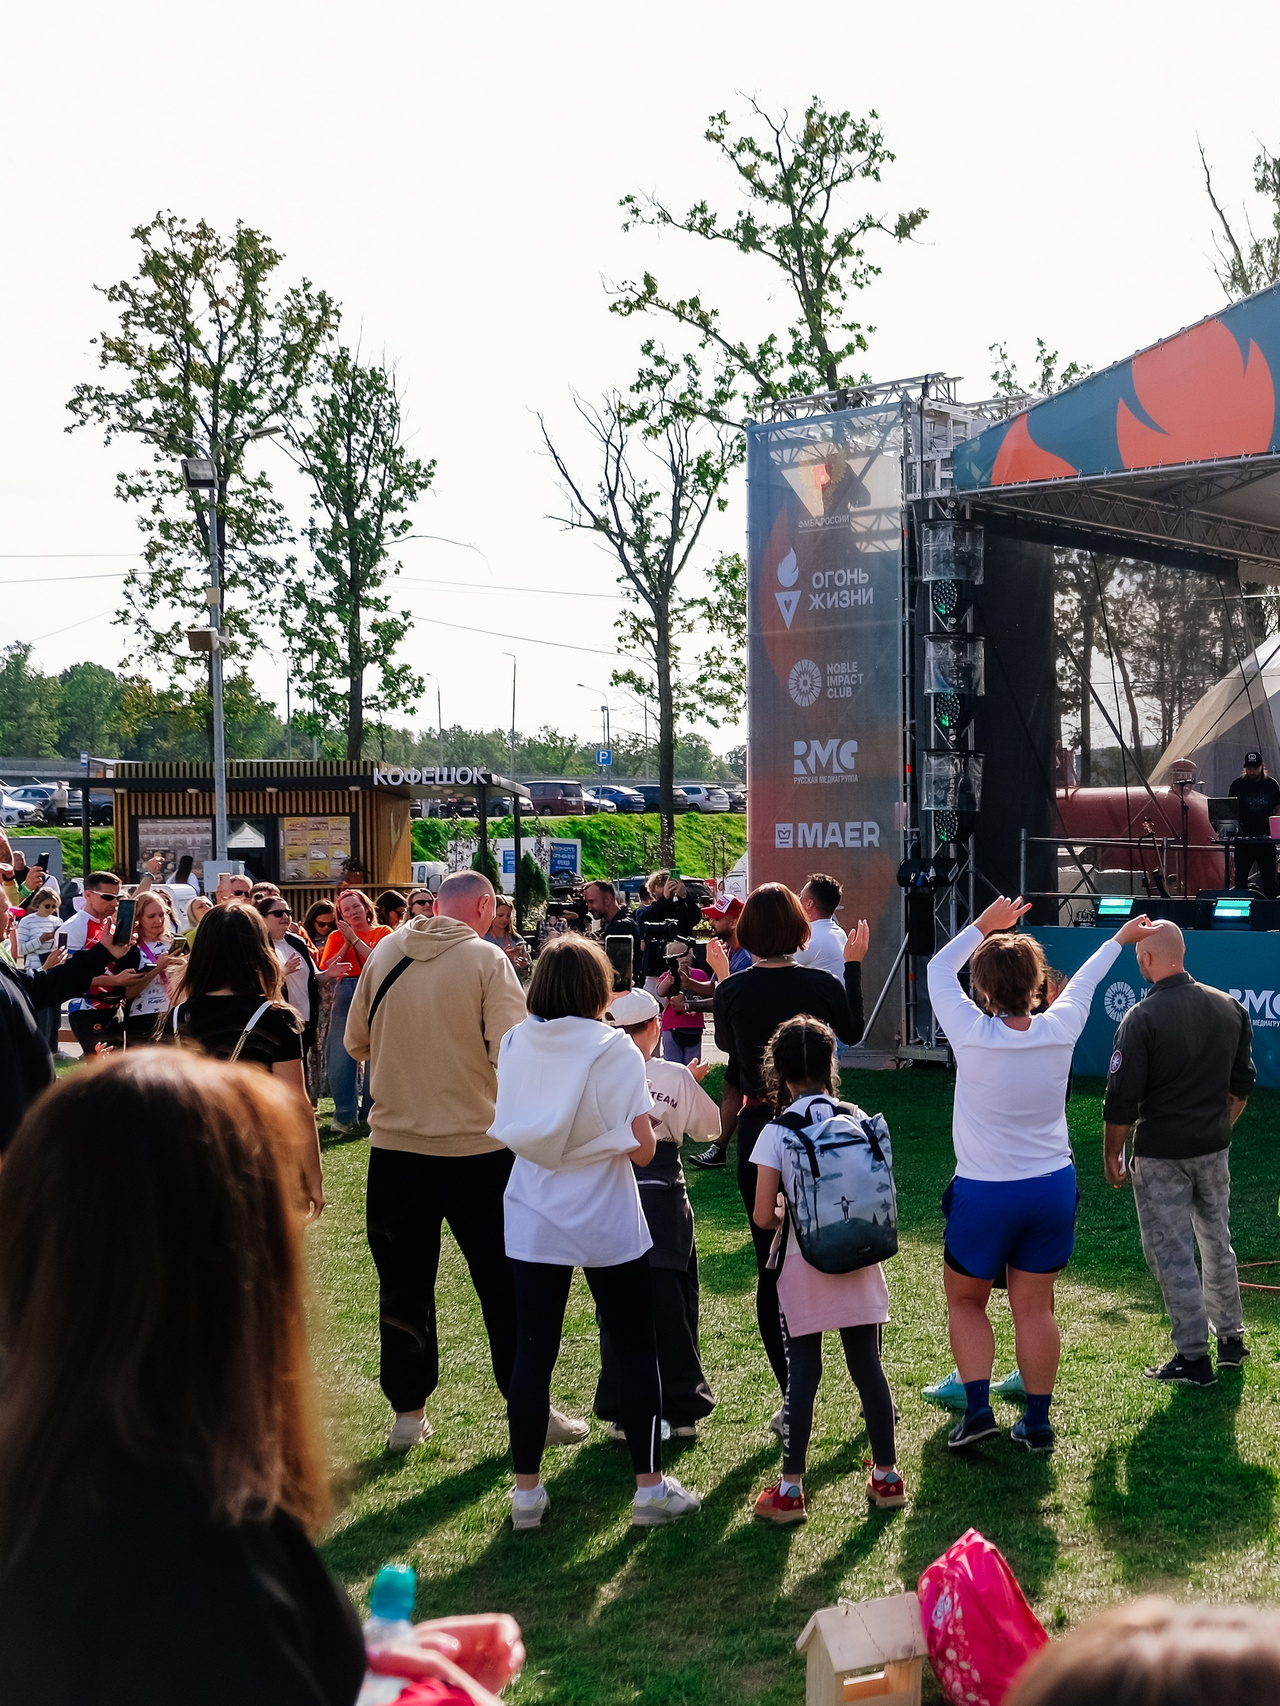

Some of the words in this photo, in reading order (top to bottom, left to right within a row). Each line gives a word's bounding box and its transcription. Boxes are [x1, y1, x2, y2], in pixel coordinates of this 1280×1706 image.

[798, 519, 821, 529] ФМБА
[822, 514, 850, 526] РОССИИ
[812, 568, 869, 589] ОГОНЬ
[808, 588, 874, 611] ЖИЗНИ
[826, 661, 858, 675] NOBLE
[826, 673, 864, 687] IMPACT
[827, 686, 852, 699] CLUB
[793, 739, 858, 775] RMG
[373, 766, 488, 787] КОФЕШОК
[793, 776, 819, 785] РУССКАЯ
[819, 774, 858, 785] МЕДИАГРУППА
[797, 821, 880, 849] MAER
[650, 1091, 678, 1109] TEAM
